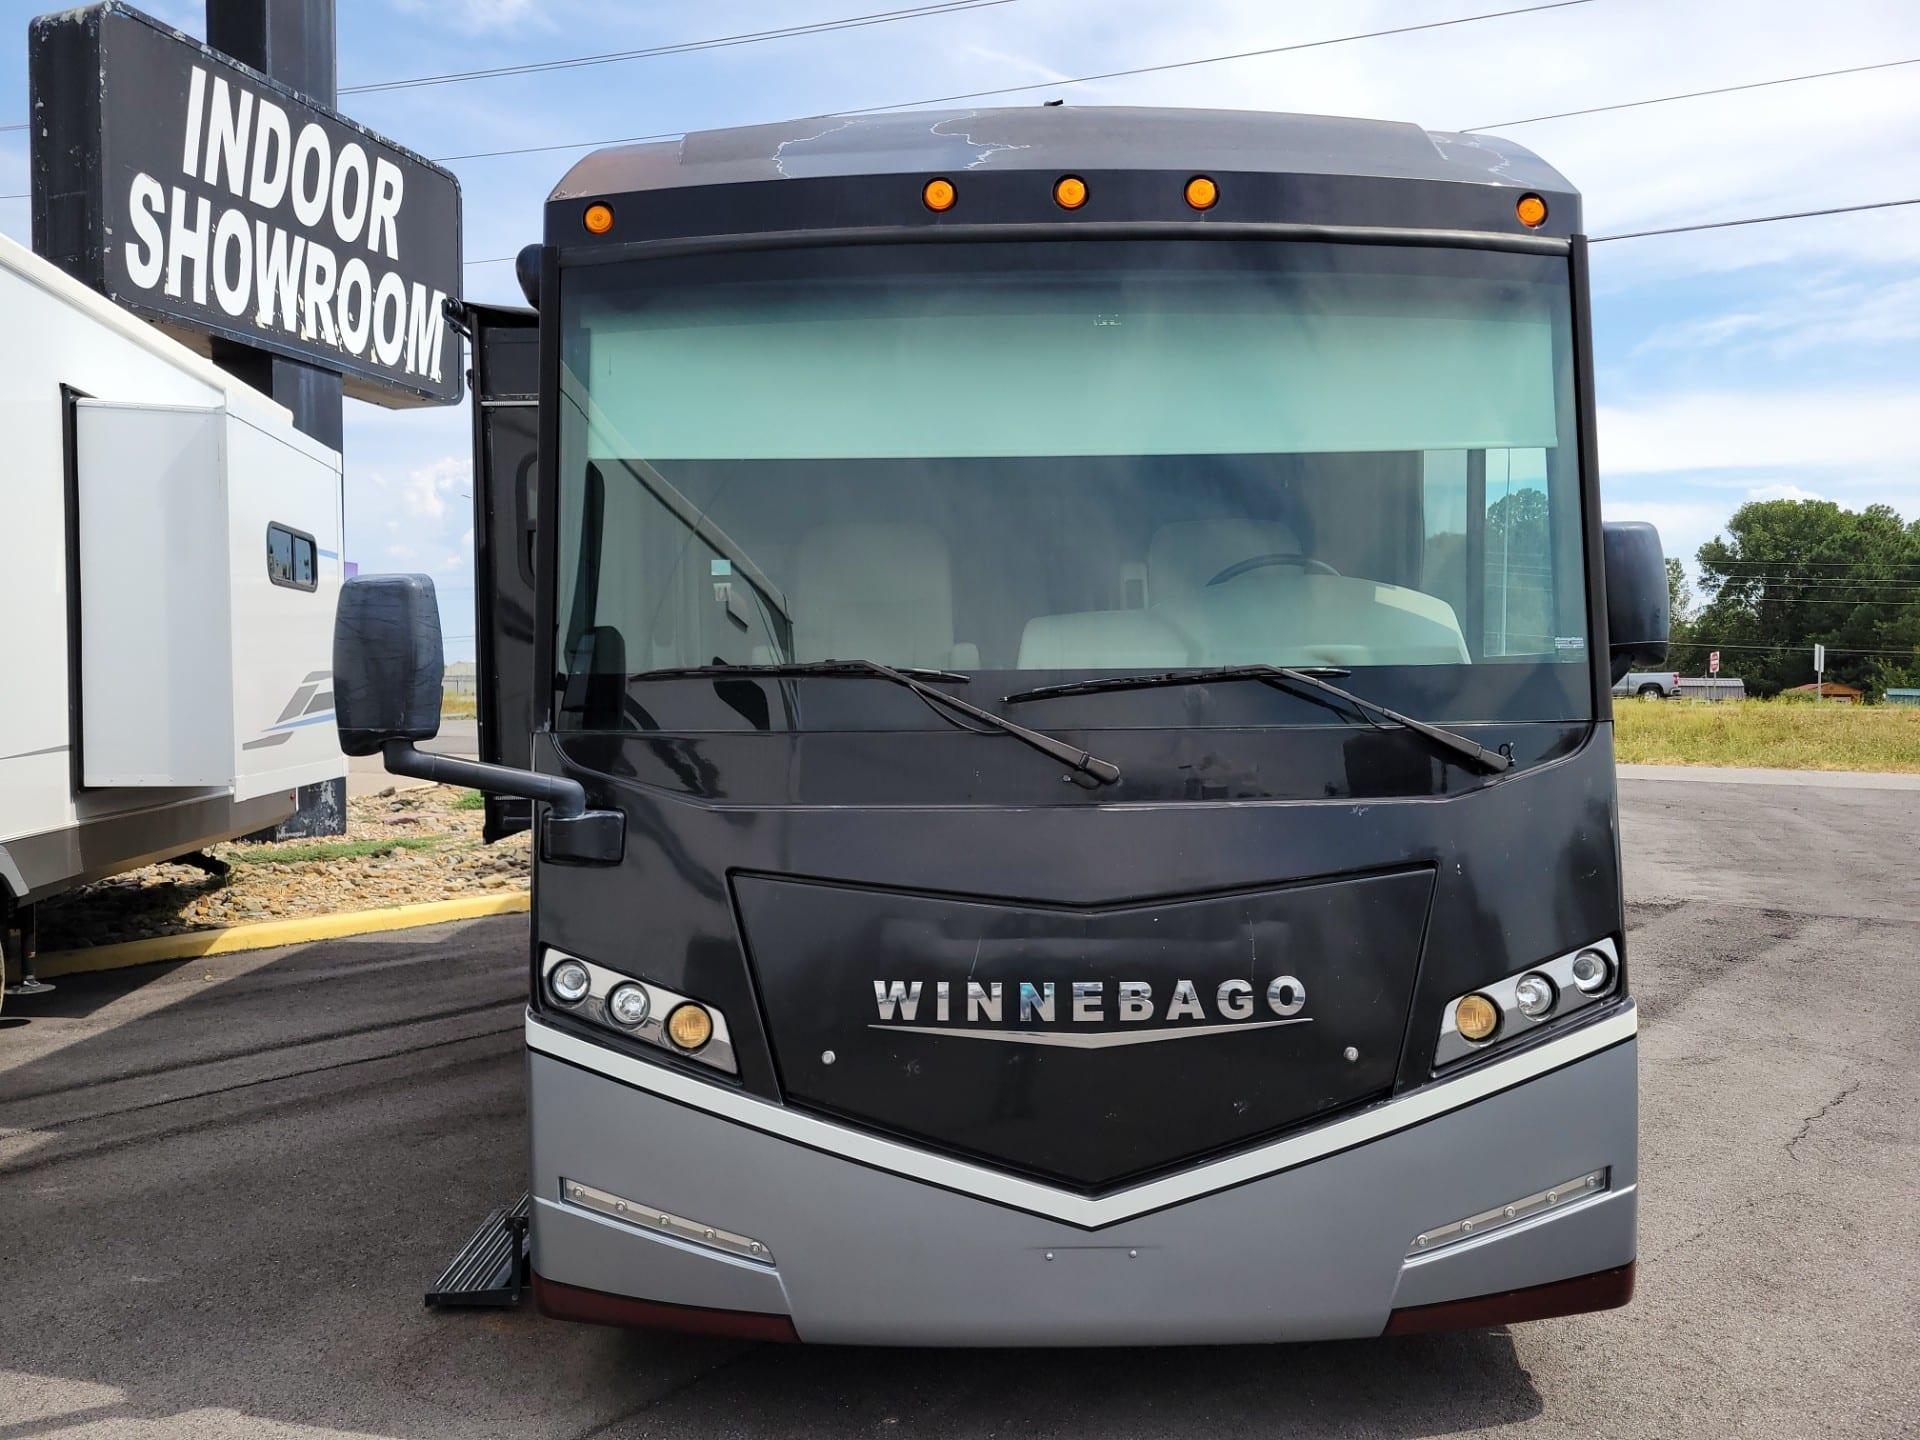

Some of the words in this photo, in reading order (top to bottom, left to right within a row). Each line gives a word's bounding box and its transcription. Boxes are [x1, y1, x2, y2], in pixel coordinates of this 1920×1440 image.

[183, 65, 403, 260] INDOOR
[125, 172, 447, 383] SHOWROOM
[873, 975, 1306, 1021] WINNEBAGO
